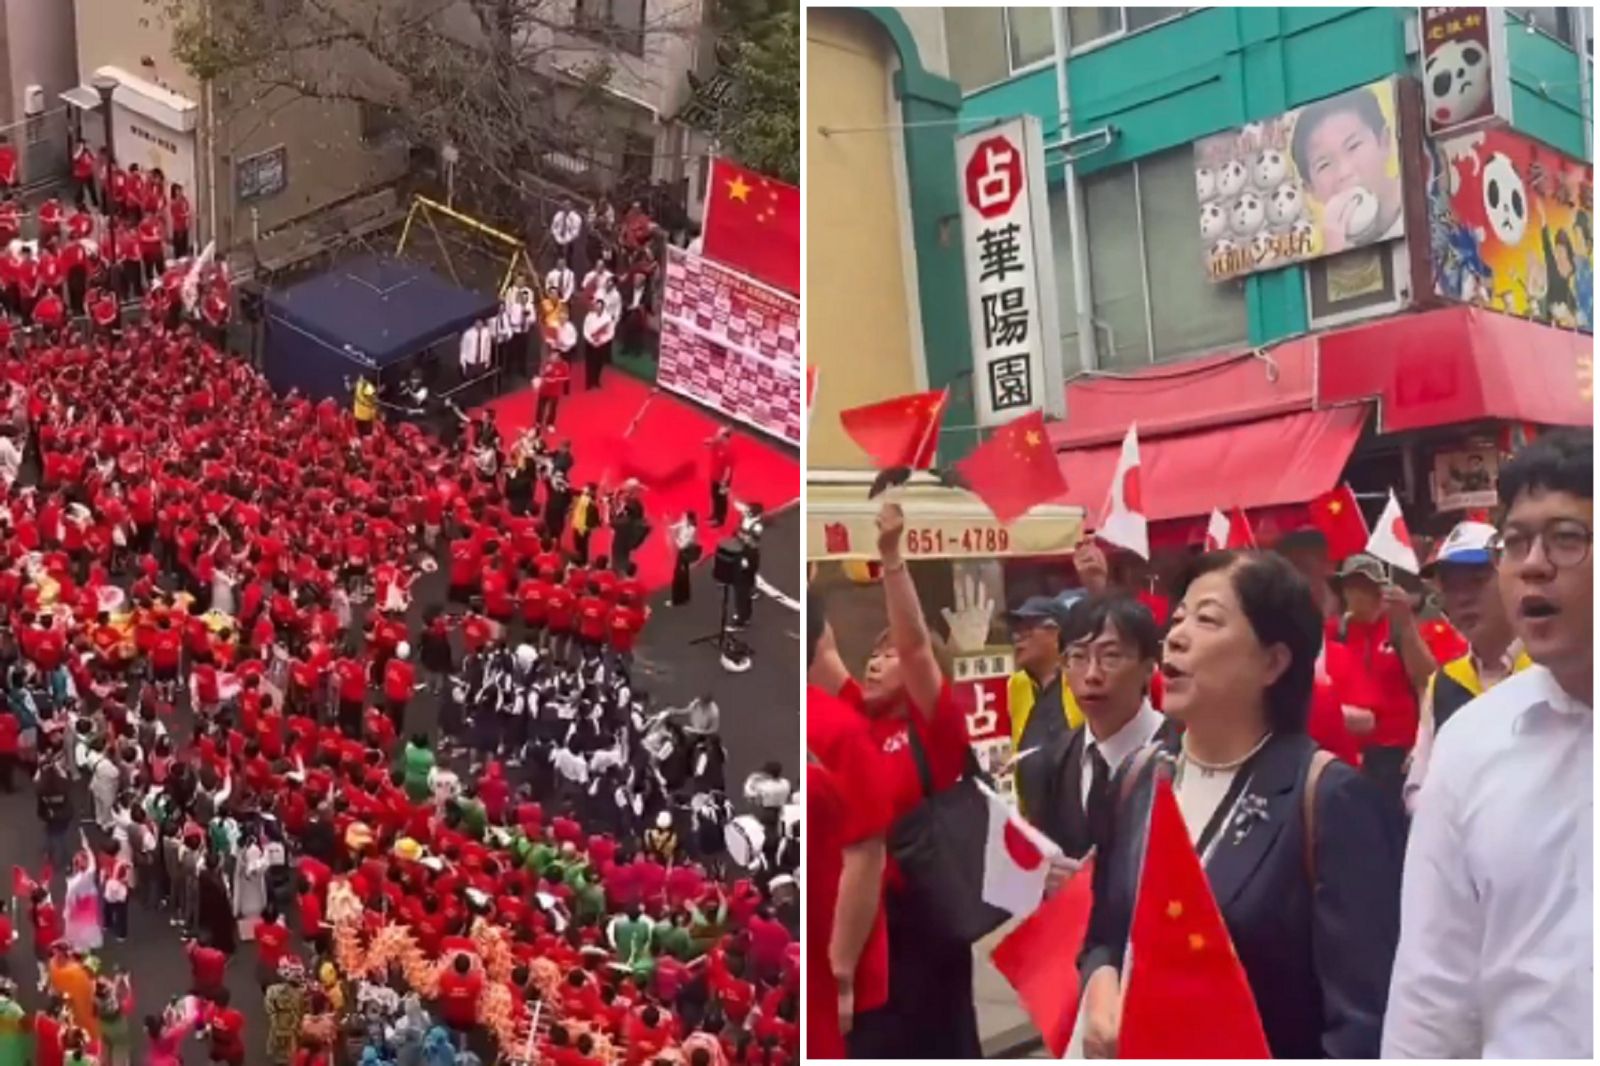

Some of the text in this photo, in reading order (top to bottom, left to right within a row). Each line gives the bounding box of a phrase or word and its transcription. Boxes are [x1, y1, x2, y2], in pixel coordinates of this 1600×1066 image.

[978, 147, 1012, 209] 占
[977, 222, 1033, 412] 華陽園
[907, 528, 1009, 554] 651-4789
[964, 682, 999, 737] 占
